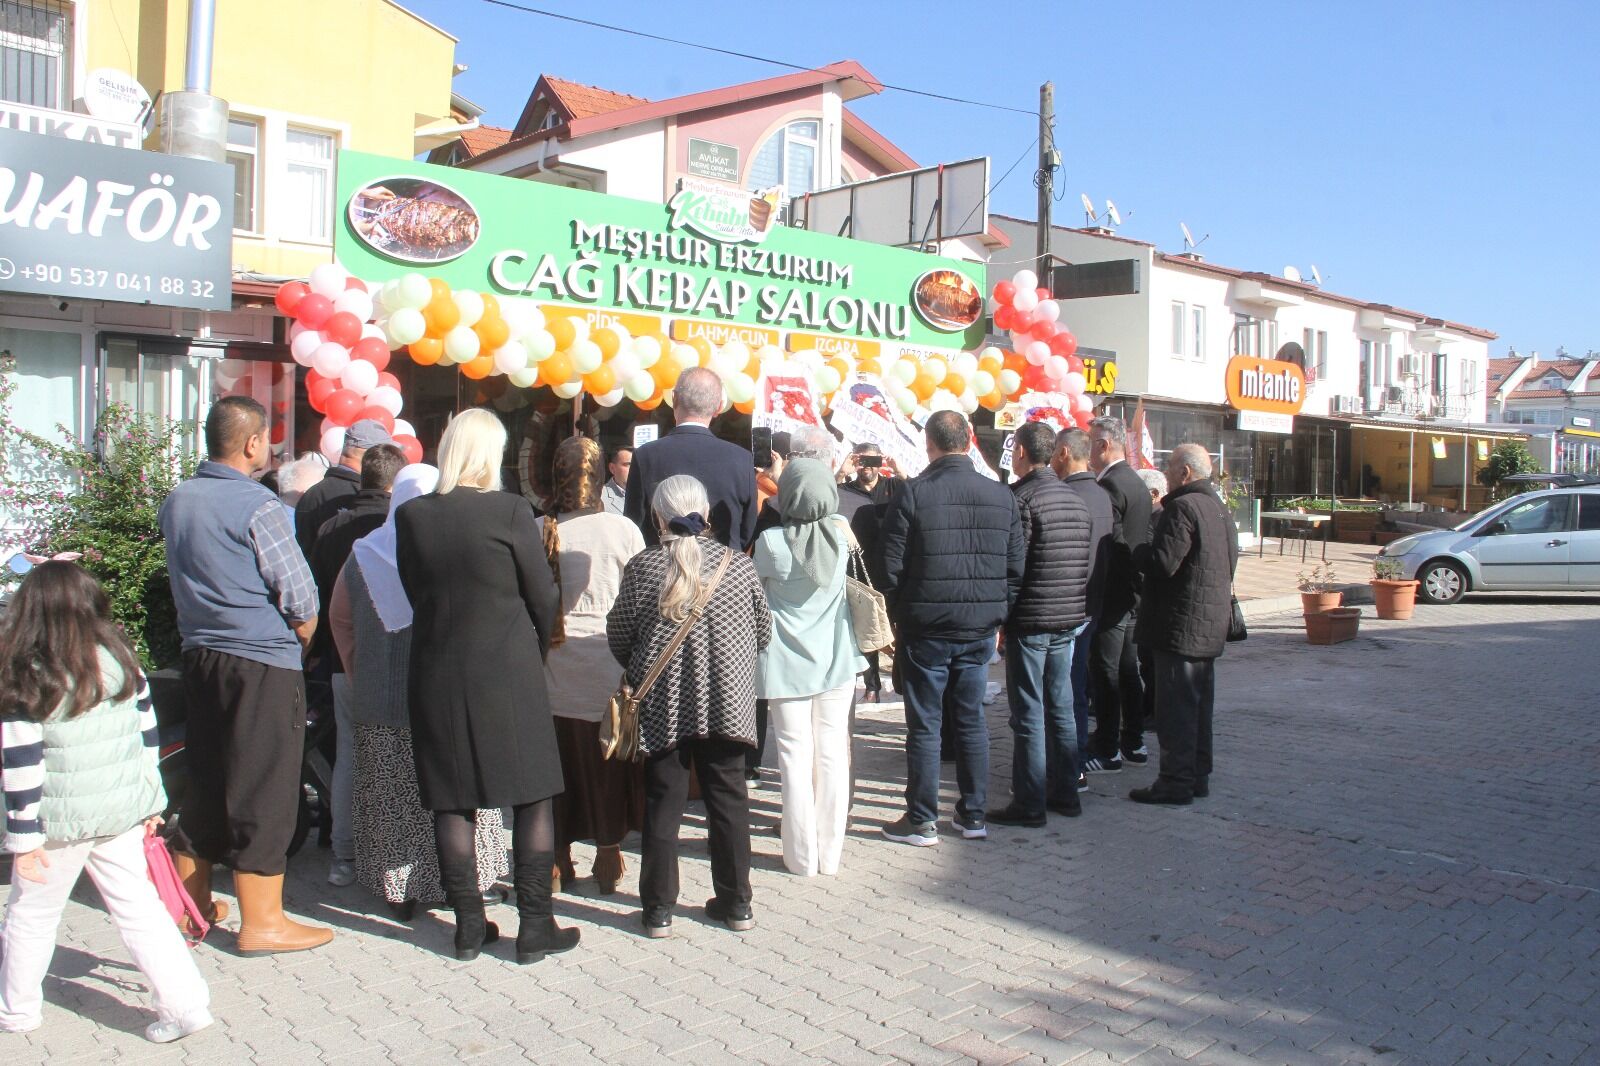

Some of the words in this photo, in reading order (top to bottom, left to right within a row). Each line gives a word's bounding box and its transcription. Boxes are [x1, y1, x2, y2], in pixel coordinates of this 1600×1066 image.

[0, 110, 133, 148] UKAT
[699, 153, 729, 166] AVUKAT
[573, 218, 711, 264] MEŞHUR
[720, 242, 853, 286] ERZURUM
[20, 263, 62, 283] +90
[70, 267, 108, 288] 537
[116, 271, 151, 292] 041
[160, 276, 185, 295] 88
[191, 279, 215, 298] 32
[491, 249, 604, 300] CAĞ
[617, 262, 752, 316] KEBAP
[759, 285, 911, 338] SALONU
[688, 323, 768, 345] LAHMACUN
[815, 337, 859, 356] IZGARA
[1241, 364, 1300, 404] miante
